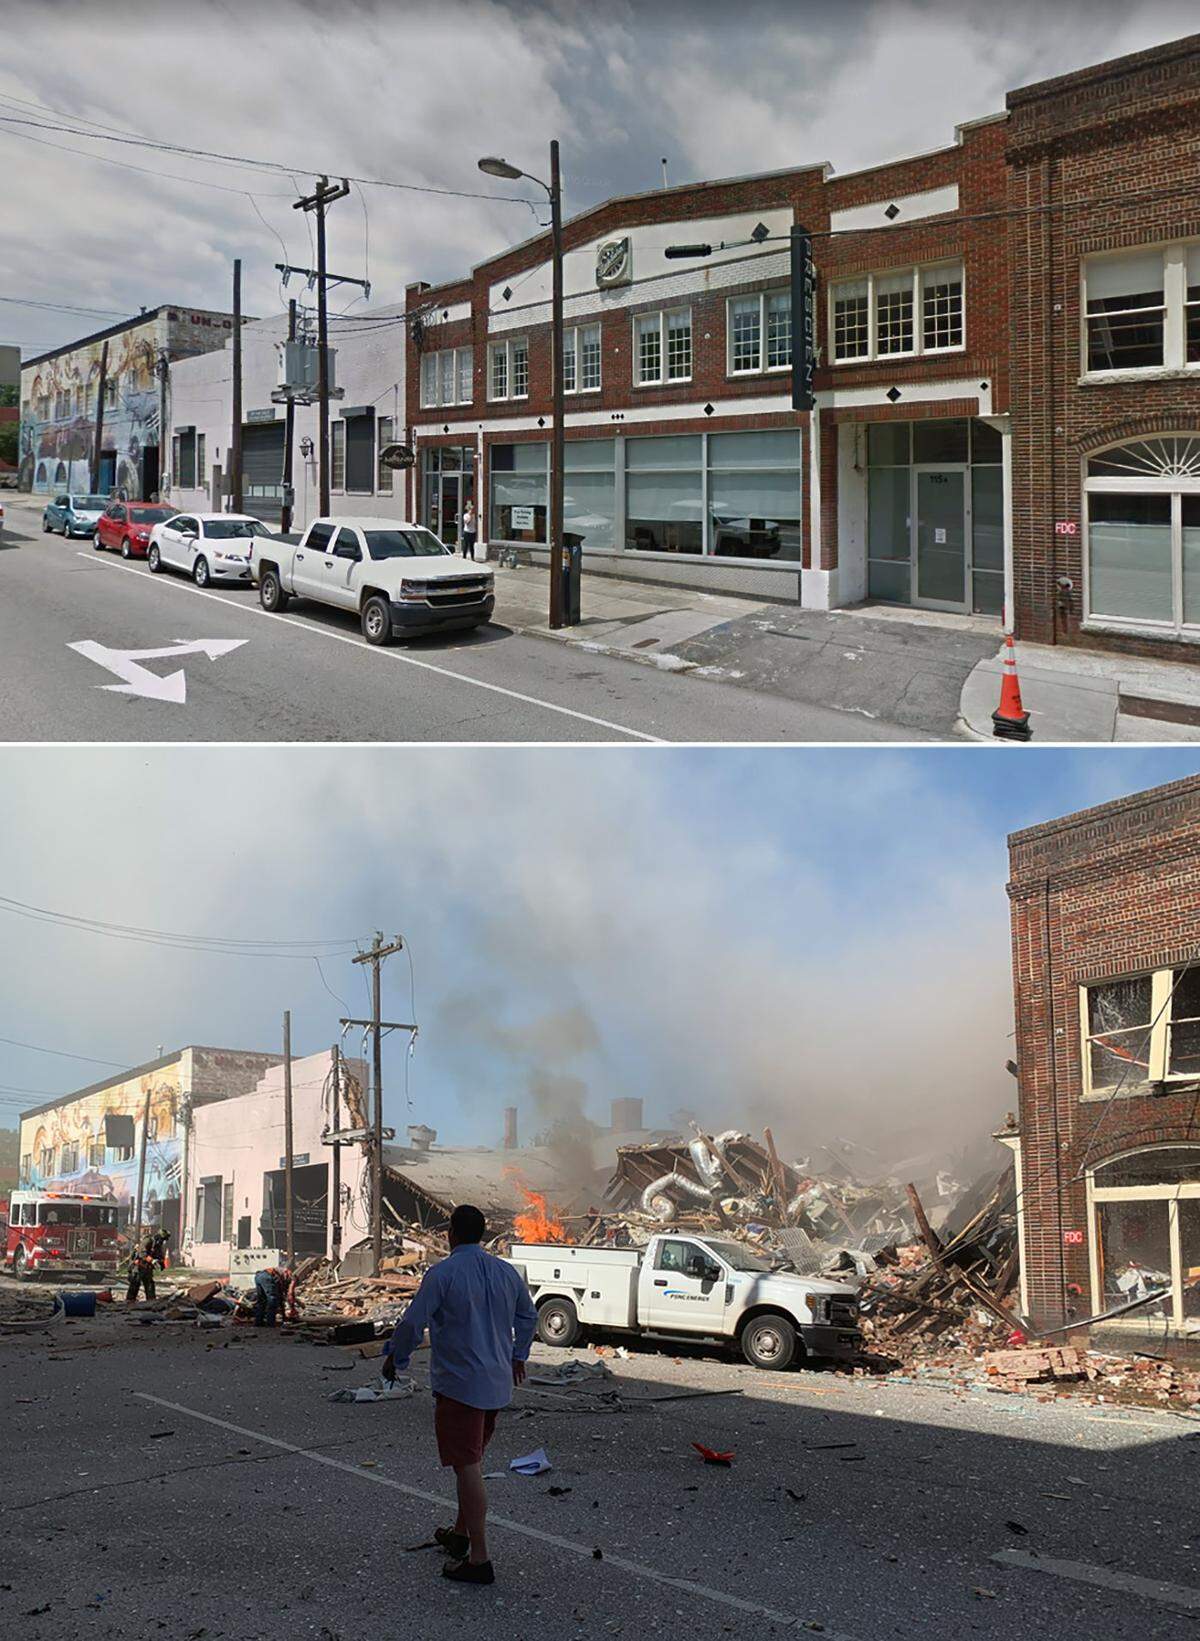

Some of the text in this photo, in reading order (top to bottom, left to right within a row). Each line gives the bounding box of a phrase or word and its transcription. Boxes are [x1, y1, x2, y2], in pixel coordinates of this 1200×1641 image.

[804, 237, 813, 401] PRESCIENT
[1055, 522, 1076, 534] FDC
[1064, 1231, 1083, 1243] FDC
